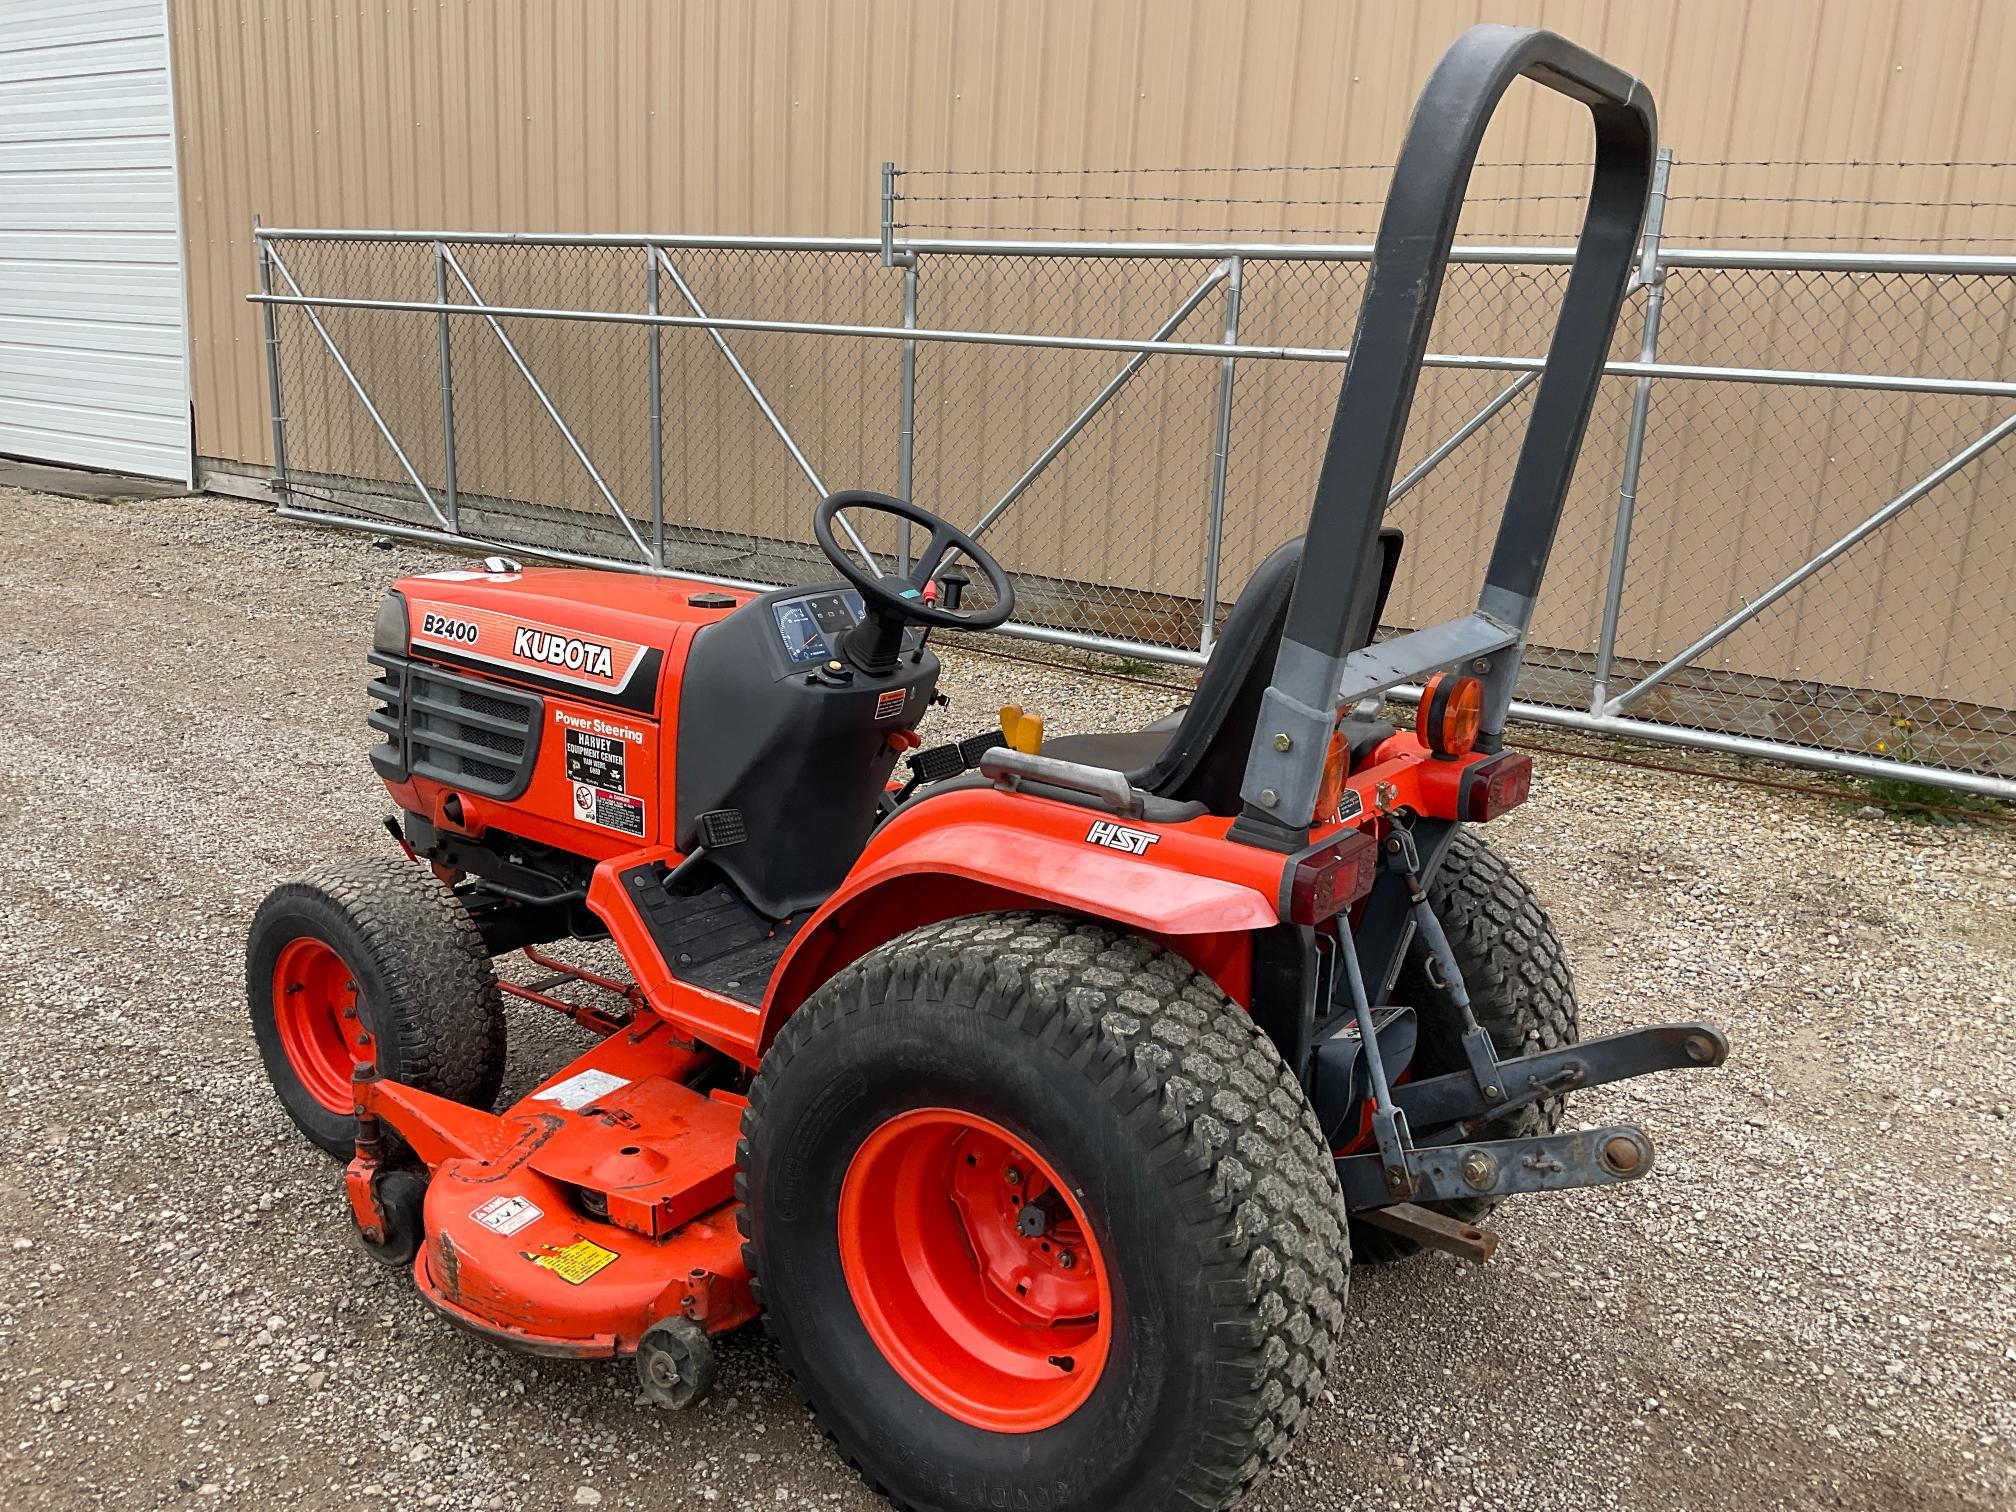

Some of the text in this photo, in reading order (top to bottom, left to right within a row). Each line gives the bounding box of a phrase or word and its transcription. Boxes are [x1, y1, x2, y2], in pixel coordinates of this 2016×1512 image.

[423, 613, 478, 644] B2400
[513, 627, 613, 678] KUBOTA
[555, 709, 643, 744] Power Steering
[578, 733, 611, 751] HARVEY
[567, 743, 623, 765] EQUIPMENT CENTER
[1085, 820, 1161, 856] HST
